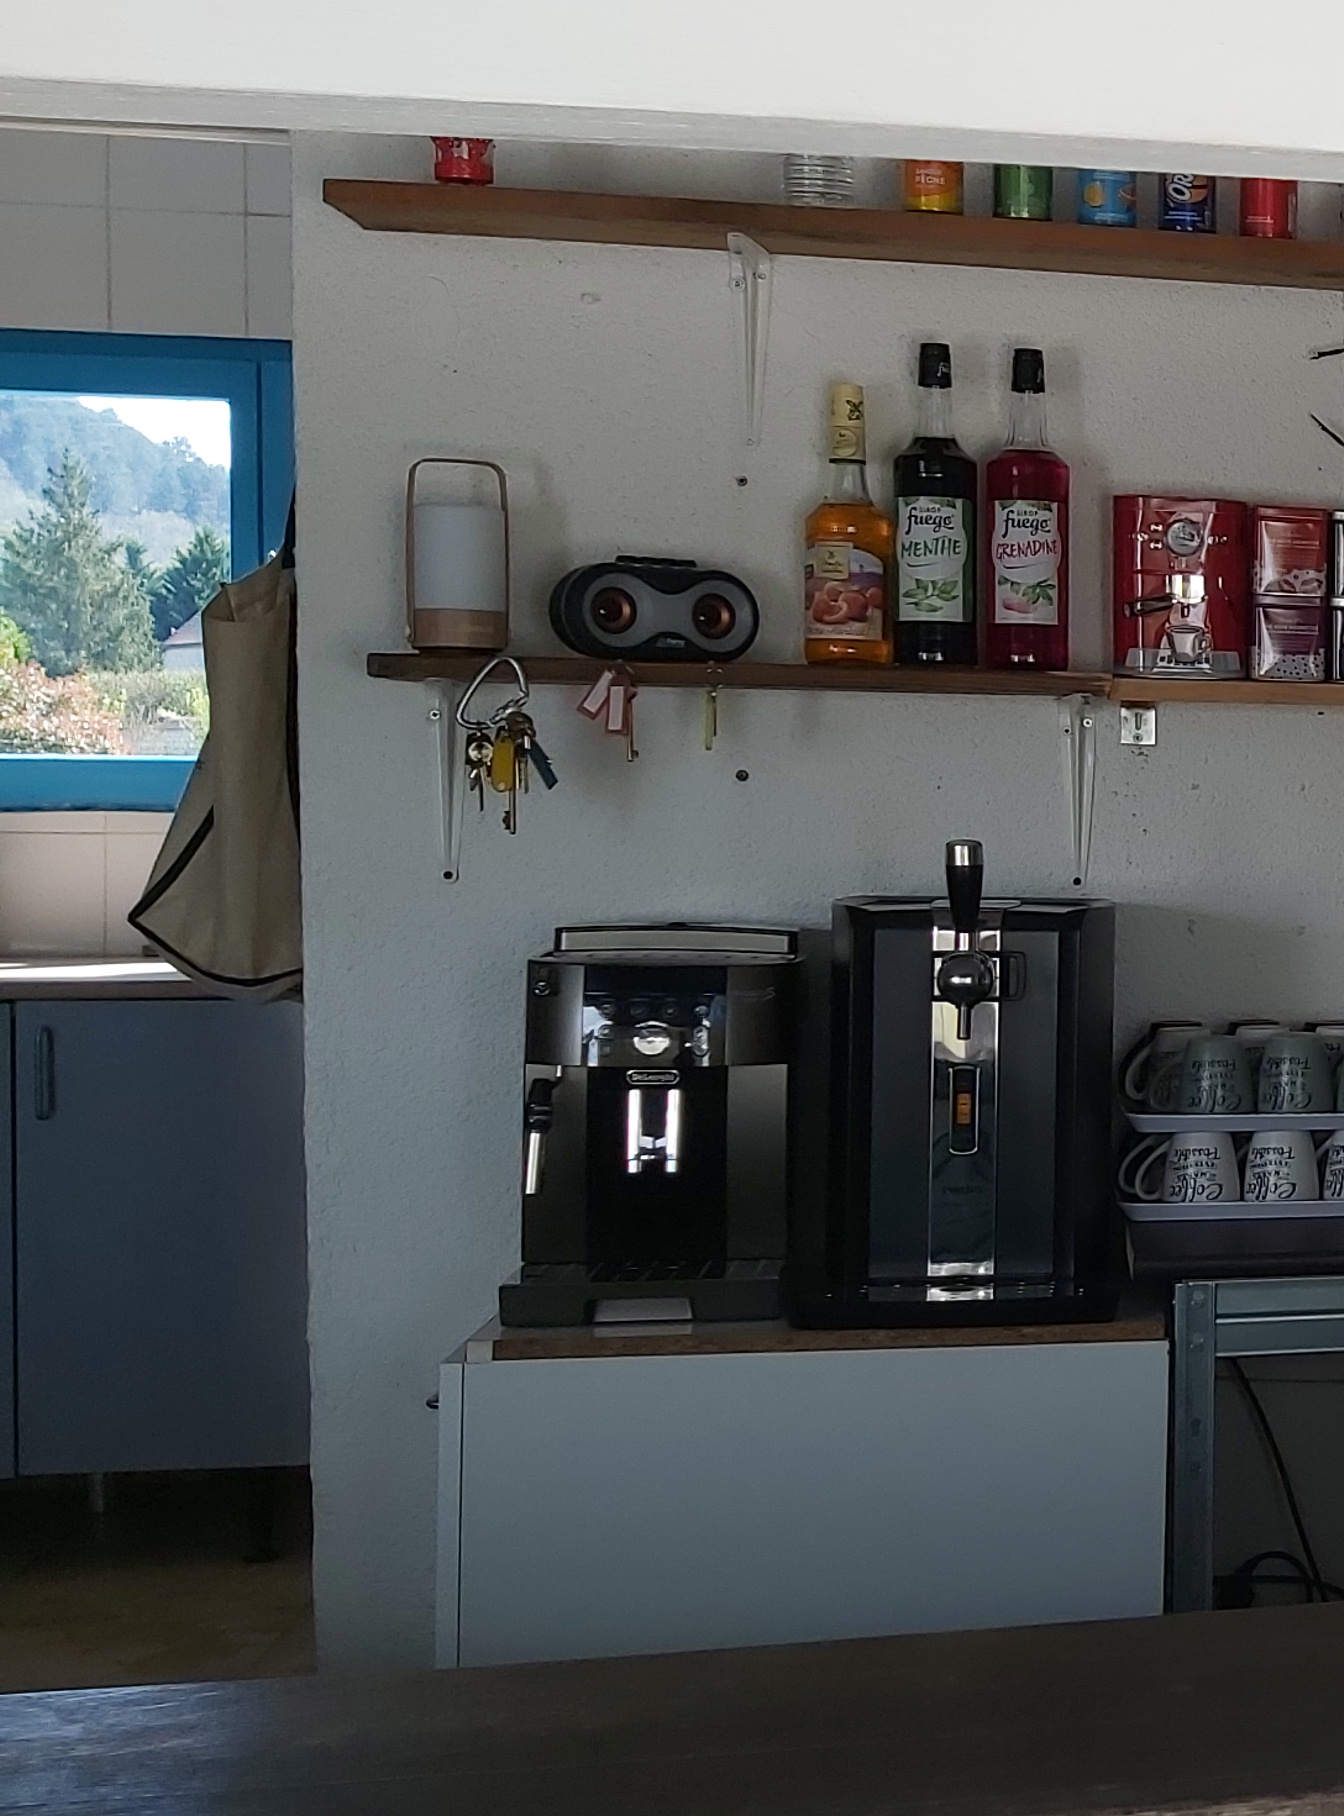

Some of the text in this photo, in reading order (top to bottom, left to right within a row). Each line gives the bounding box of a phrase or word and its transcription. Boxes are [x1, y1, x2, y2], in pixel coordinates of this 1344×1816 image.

[905, 507, 954, 535] fuego
[1002, 509, 1051, 538] fuego
[901, 536, 962, 559] MENTHE
[996, 539, 1058, 562] GRENADINE
